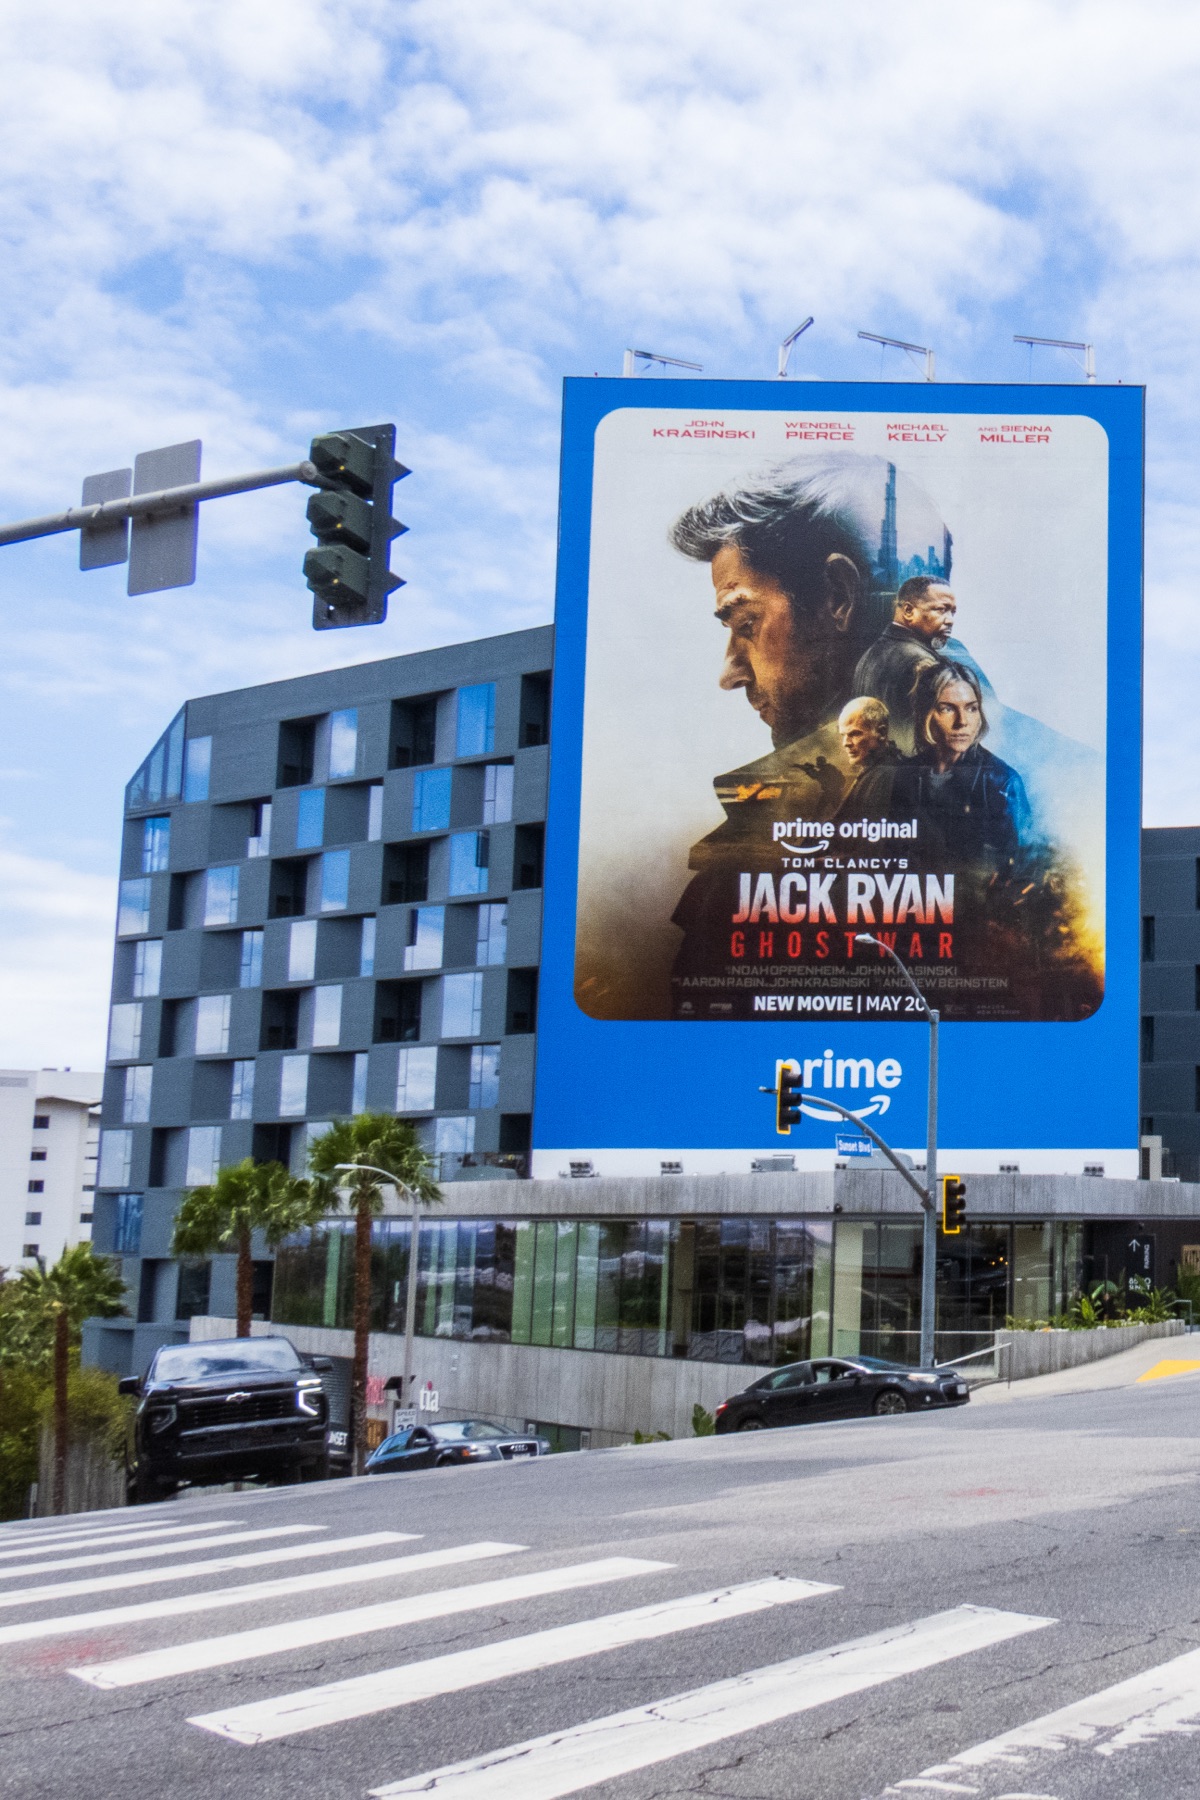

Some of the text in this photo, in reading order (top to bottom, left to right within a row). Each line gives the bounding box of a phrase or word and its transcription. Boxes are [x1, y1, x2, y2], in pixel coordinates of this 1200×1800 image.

[785, 422, 856, 430] WENDELL
[886, 424, 949, 432] MICHAEL
[1001, 425, 1052, 433] SIENNA
[653, 429, 755, 439] KRASINSKI
[786, 431, 854, 441] PIERCE
[888, 433, 947, 442] KELLY
[980, 434, 1050, 444] MILLER
[773, 818, 917, 842] prime original
[781, 857, 908, 869] TOM CLANCY'S
[732, 872, 954, 924] JACK RYAN
[754, 996, 794, 1011] NEW
[797, 996, 853, 1012] MOVIE
[866, 996, 902, 1011] MAY
